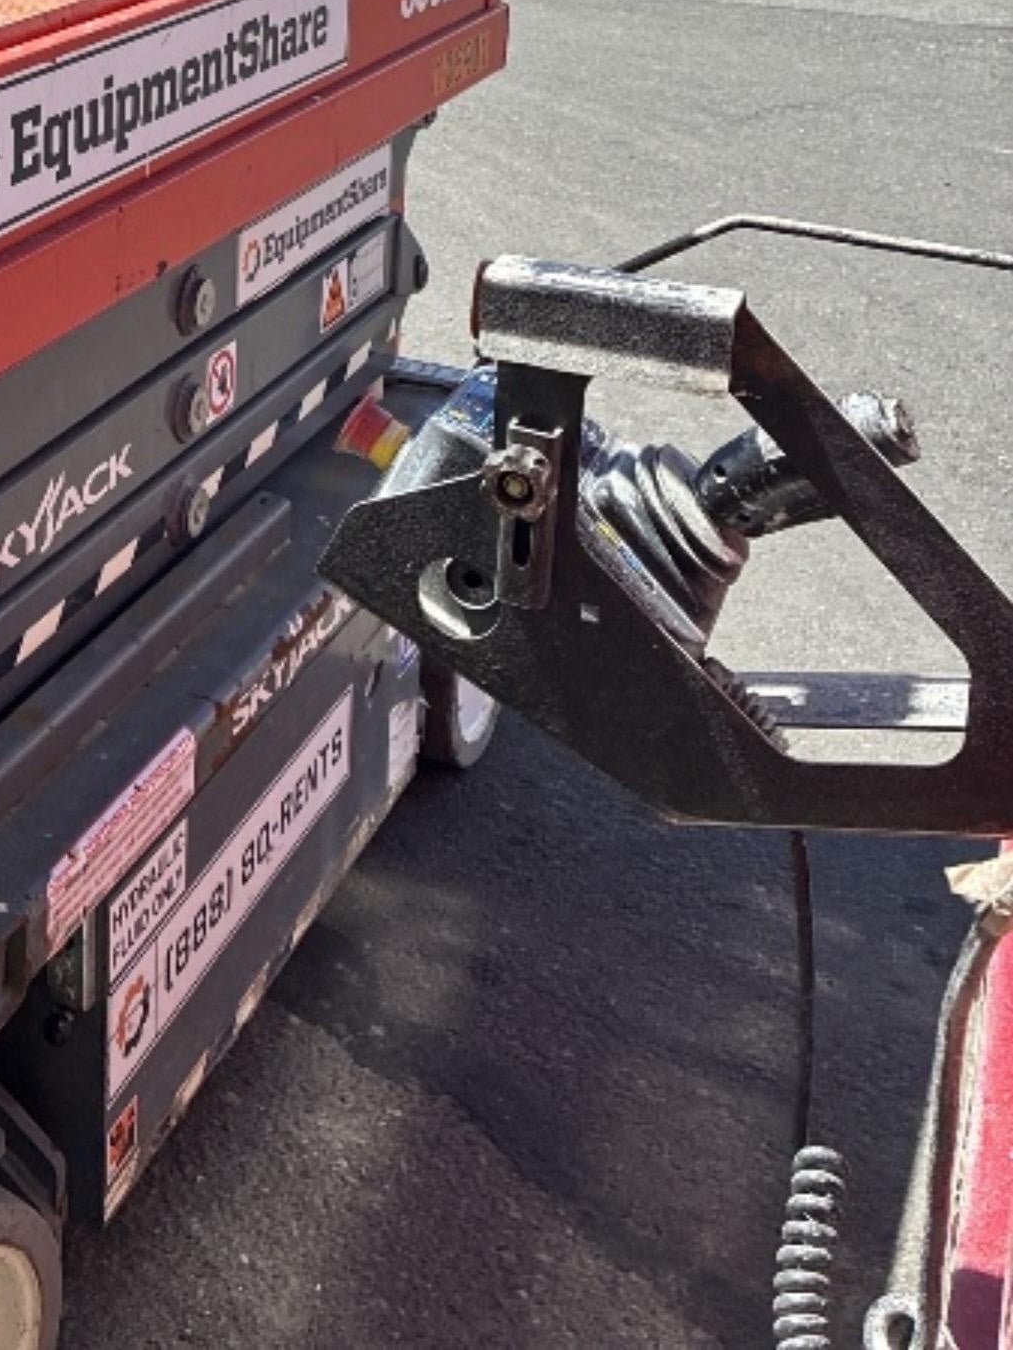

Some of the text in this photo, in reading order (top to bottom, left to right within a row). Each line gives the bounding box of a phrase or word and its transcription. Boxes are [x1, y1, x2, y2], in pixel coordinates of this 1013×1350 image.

[10, 2, 329, 186] EquipmentShare
[262, 166, 388, 268] EquipmentShare
[162, 727, 343, 995] (888) 80-RENTS
